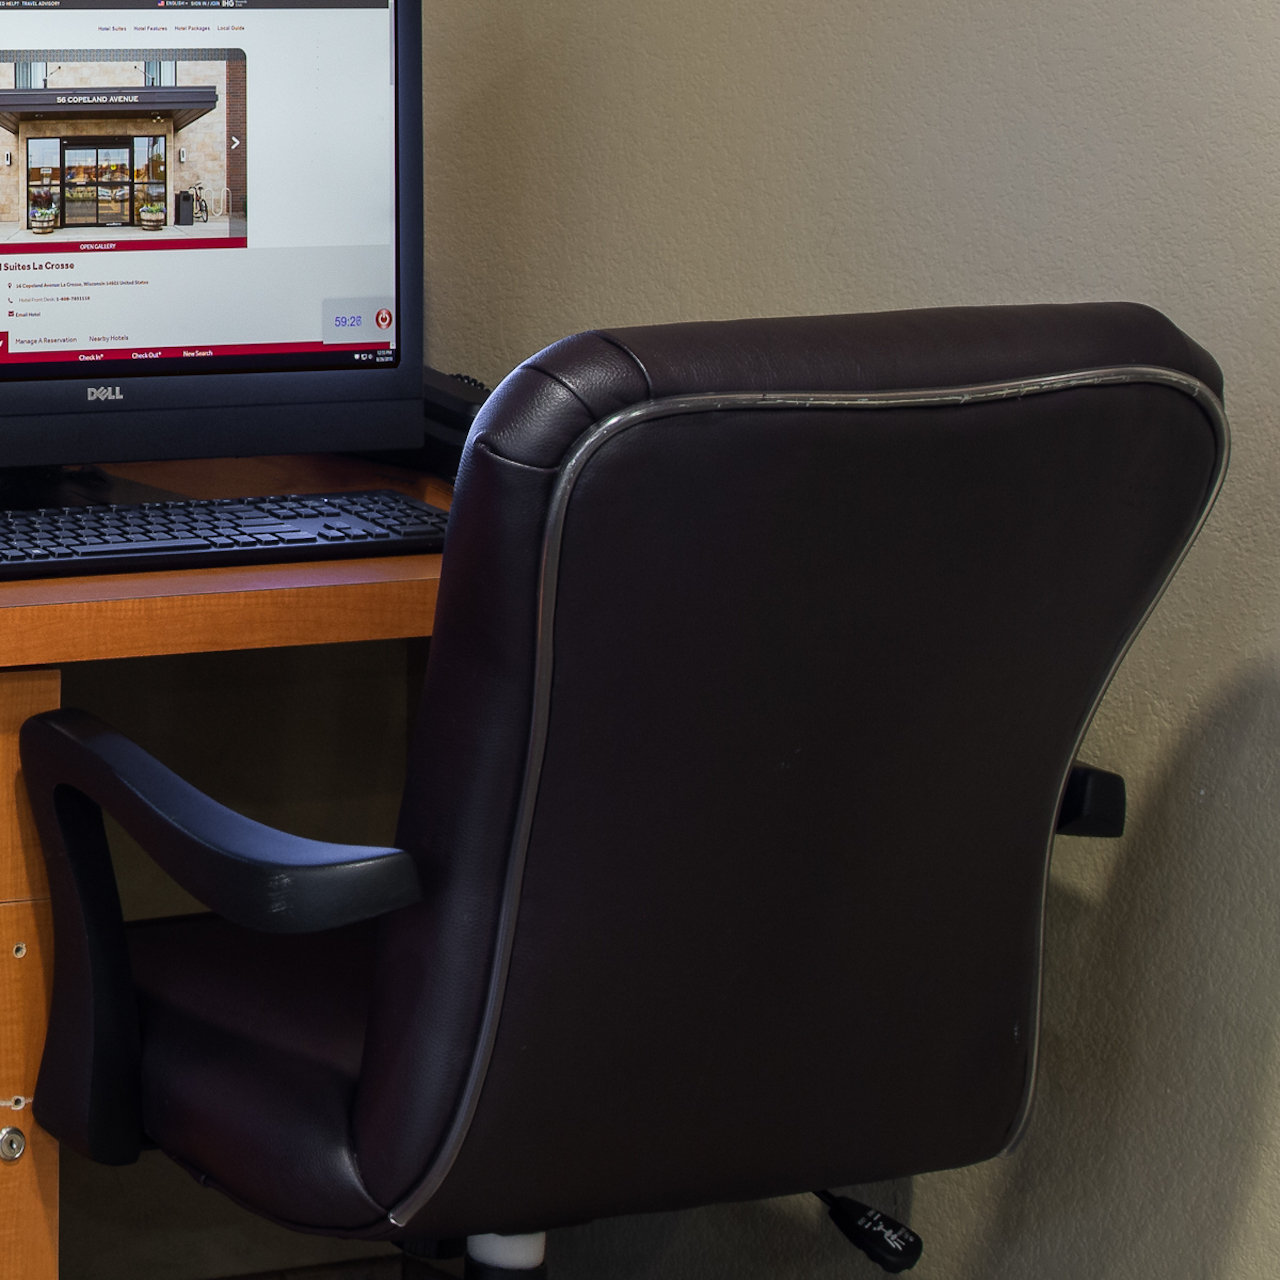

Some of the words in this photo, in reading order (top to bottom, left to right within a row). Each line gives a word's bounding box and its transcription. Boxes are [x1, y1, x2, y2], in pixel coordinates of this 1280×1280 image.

[109, 95, 139, 103] AVENUE
[3, 261, 31, 271] Suites
[33, 261, 43, 270] La
[44, 261, 75, 270] Crosse
[87, 386, 123, 400] DELL
